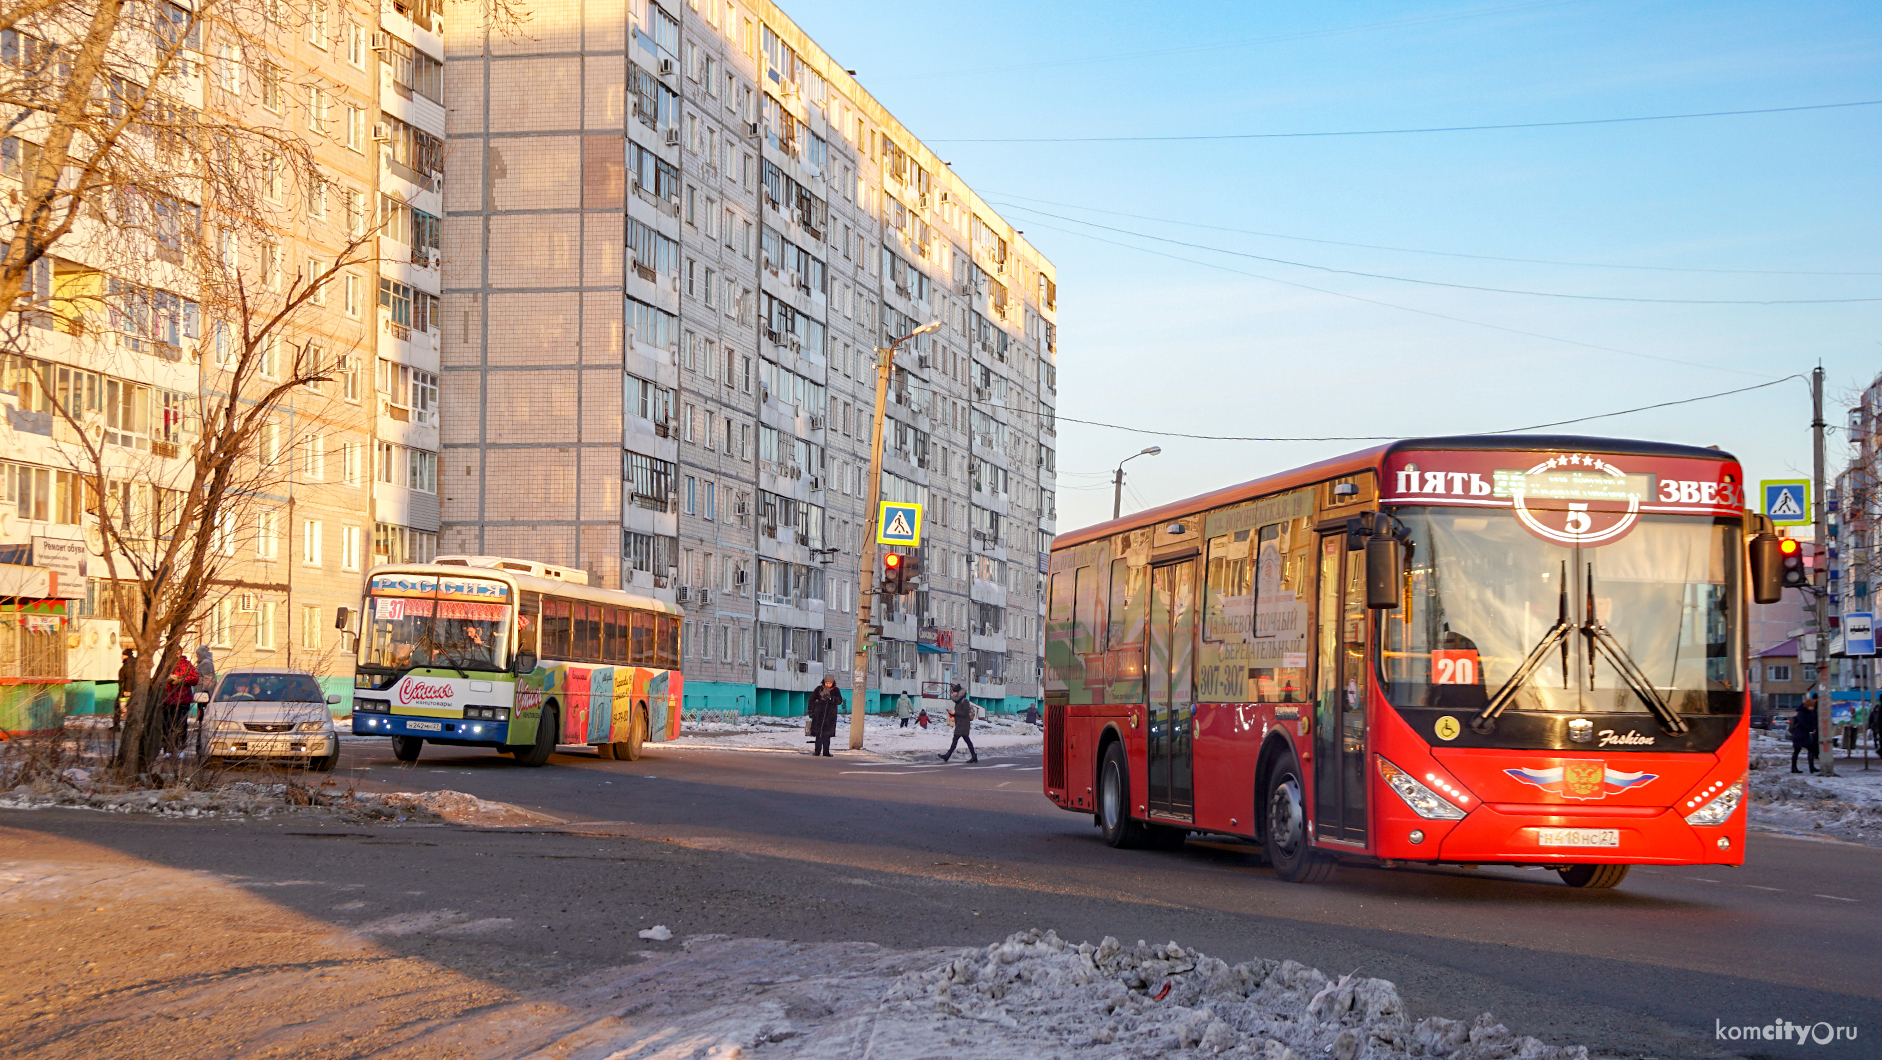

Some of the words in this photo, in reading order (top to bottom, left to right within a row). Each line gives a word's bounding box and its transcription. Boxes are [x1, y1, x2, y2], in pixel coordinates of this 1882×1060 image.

[1395, 470, 1492, 496] ПЯТЬ
[1291, 495, 1303, 516] 19
[1564, 502, 1592, 534] 5
[44, 541, 66, 552] Ремонт
[67, 543, 86, 555] обуви
[376, 578, 503, 598] РОССИЯ
[388, 599, 404, 619] 37
[1205, 608, 1299, 639] ДАЛЬНЕВОСТОЧНЫЙ
[1200, 664, 1245, 697] 307-307
[1438, 658, 1473, 685] 20
[399, 677, 454, 705] Стиль
[1598, 729, 1655, 747] Fashion
